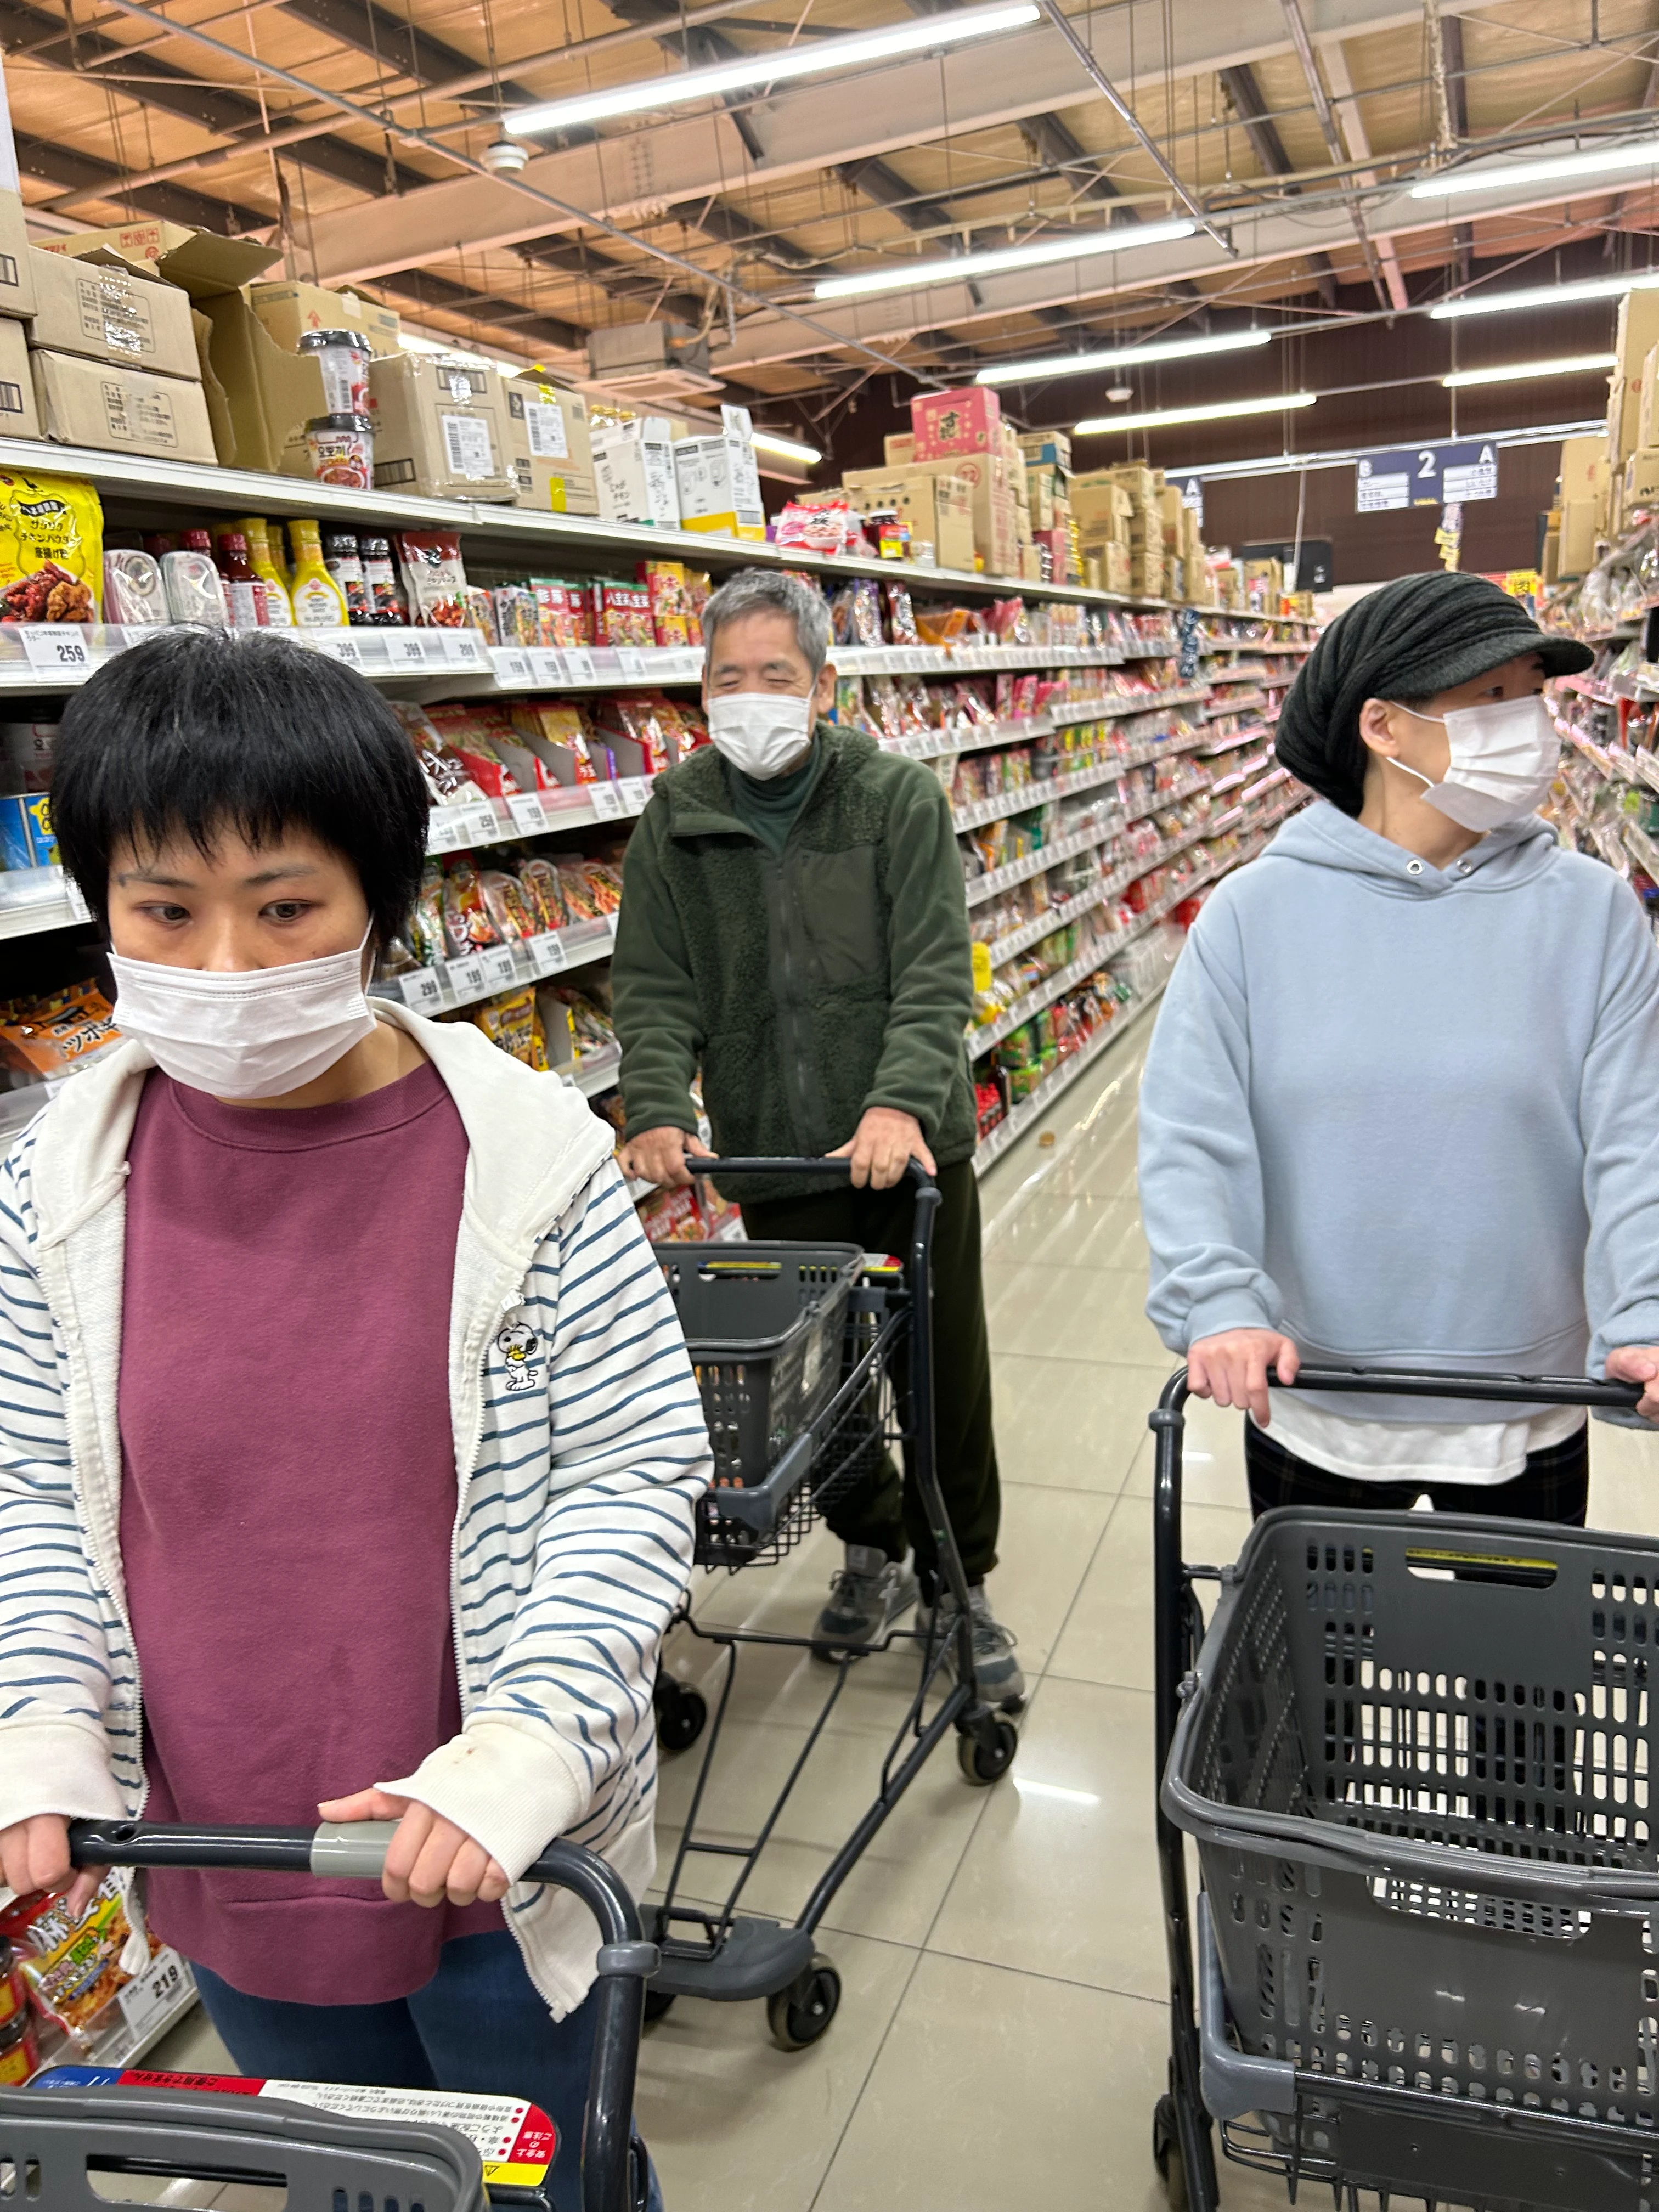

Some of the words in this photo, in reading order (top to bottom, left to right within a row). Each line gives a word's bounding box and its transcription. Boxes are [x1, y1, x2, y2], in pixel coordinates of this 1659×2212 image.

[1358, 459, 1372, 478] B
[1417, 449, 1437, 479] 2
[1479, 444, 1494, 465] A
[1186, 478, 1200, 494] A
[57, 645, 86, 662] 259
[517, 2148, 547, 2159] 安全上
